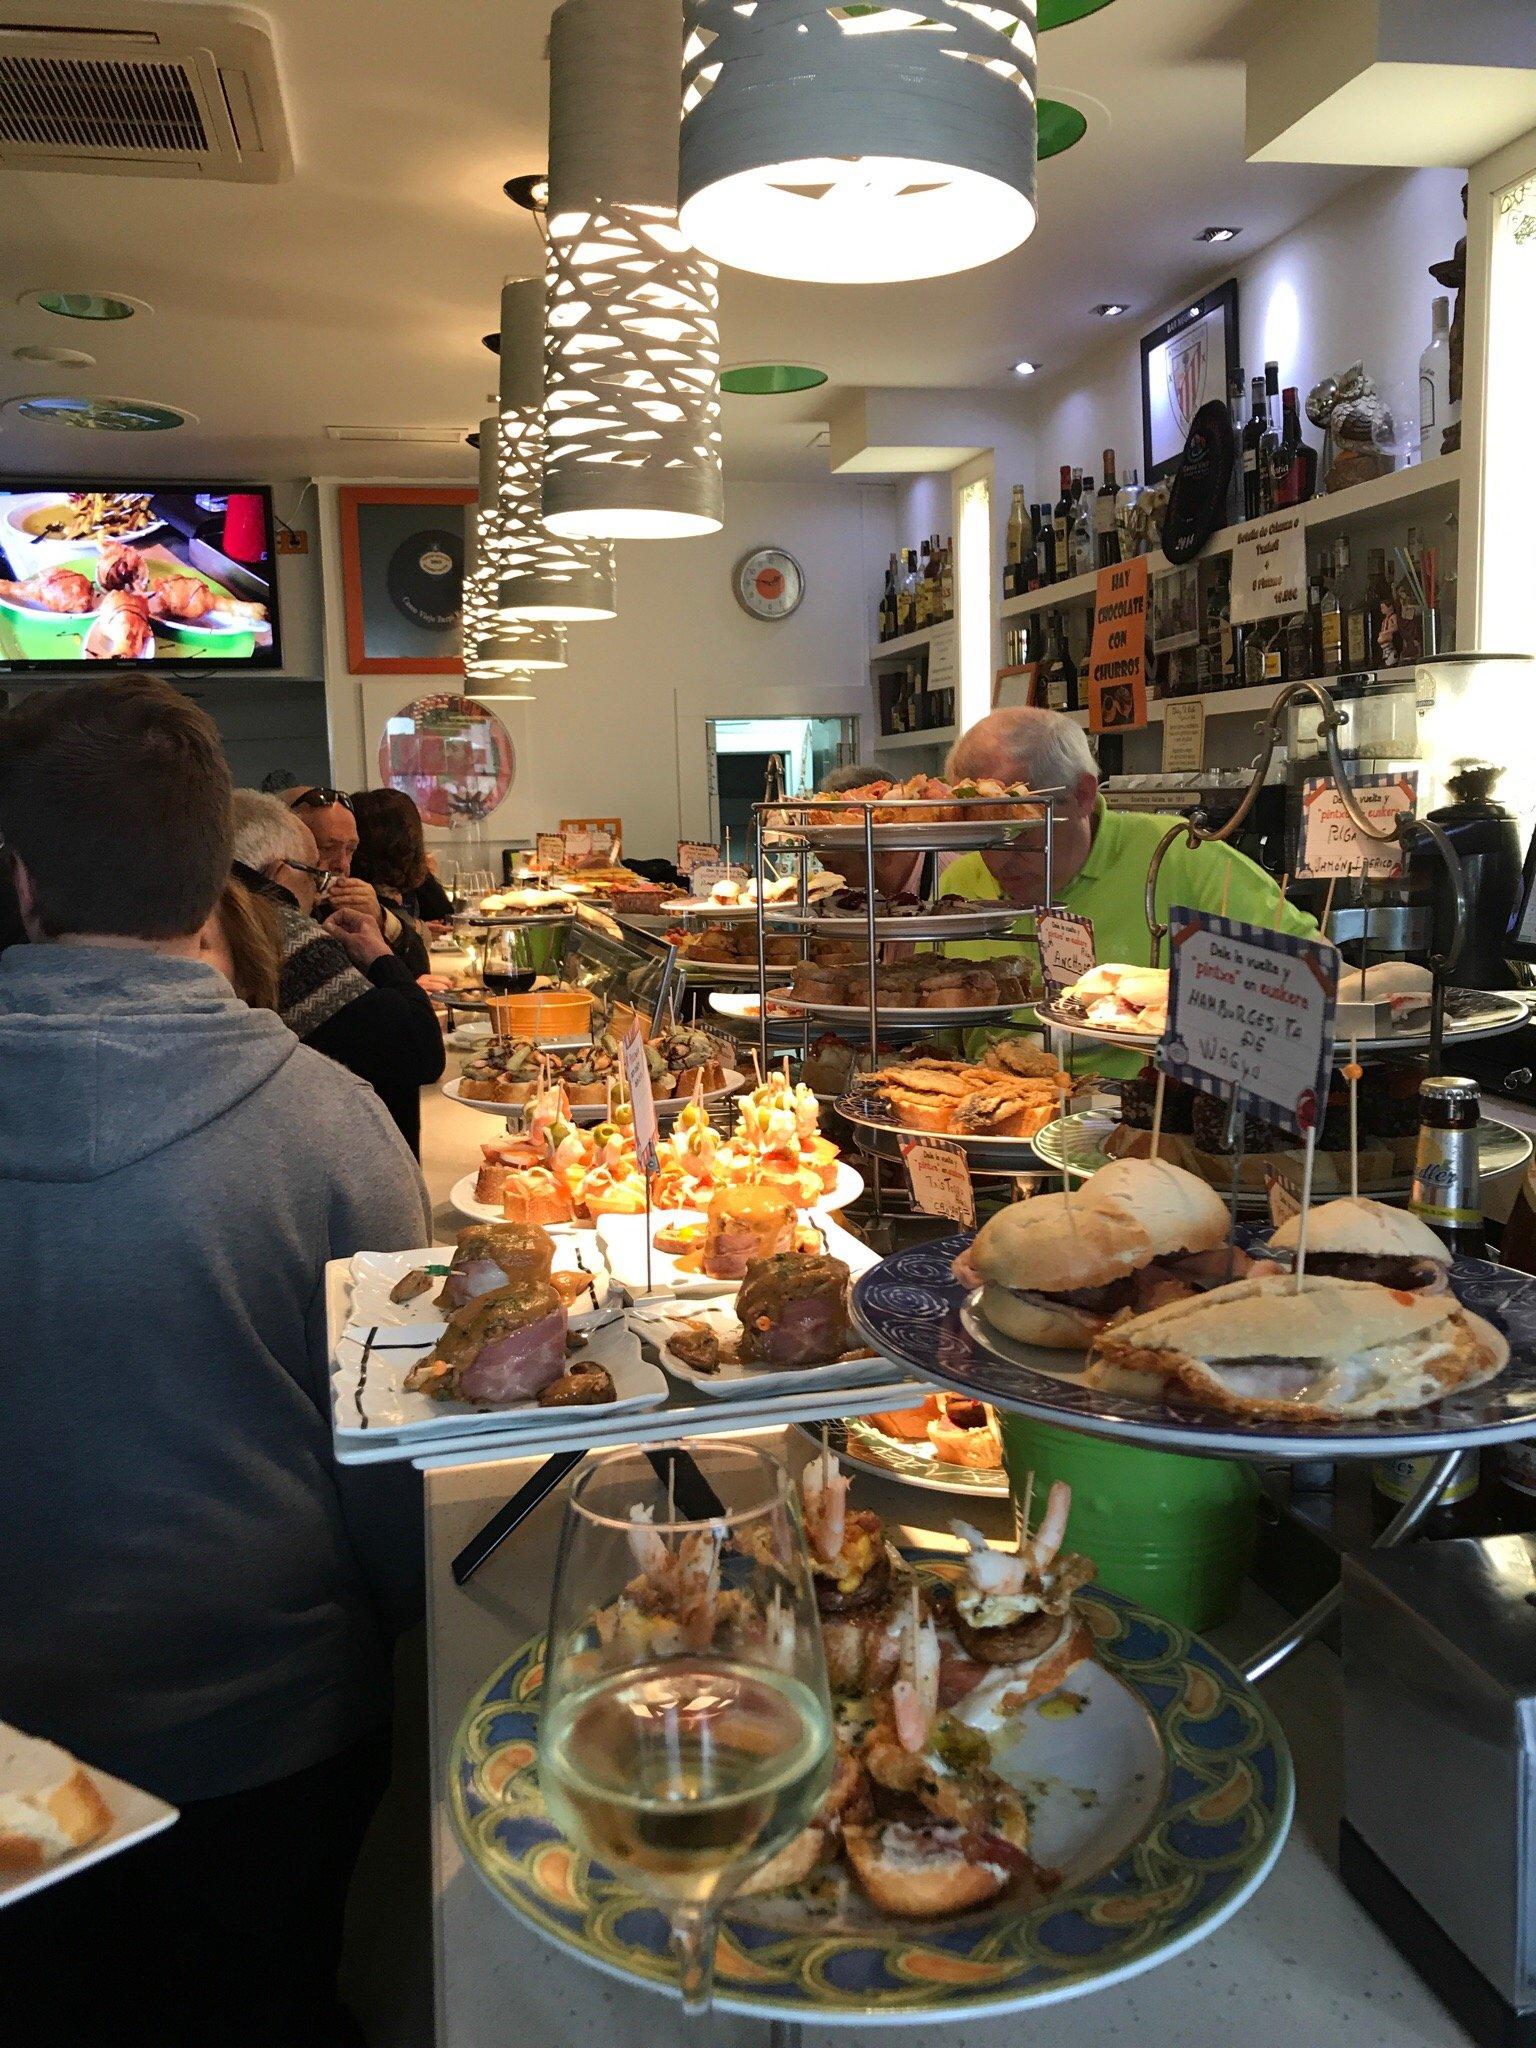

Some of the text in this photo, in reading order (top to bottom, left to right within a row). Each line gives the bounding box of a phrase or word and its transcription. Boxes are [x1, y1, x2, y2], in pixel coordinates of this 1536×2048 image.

[1111, 569, 1131, 591] HAY
[1097, 595, 1144, 625] CHOCOLATE
[1108, 630, 1128, 650] CON
[1094, 656, 1140, 682] CHURROS
[1240, 1030, 1266, 1053] DE
